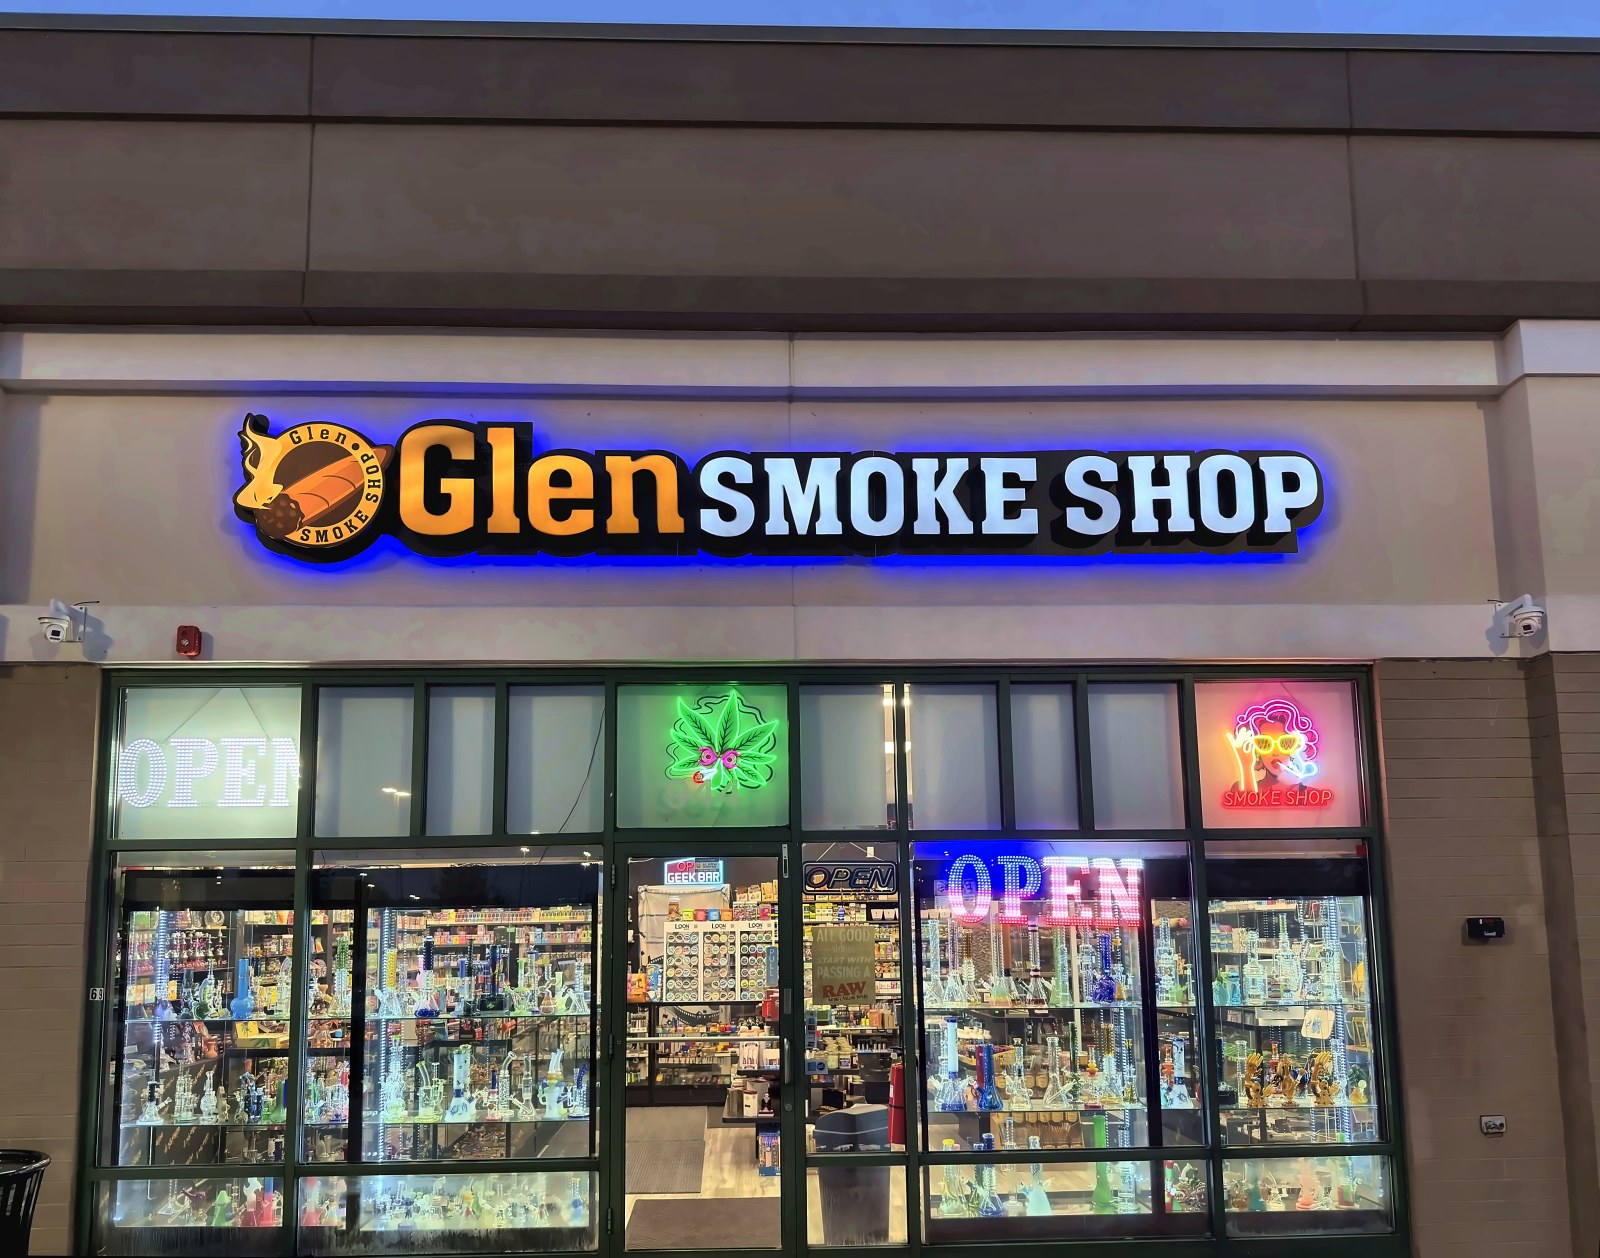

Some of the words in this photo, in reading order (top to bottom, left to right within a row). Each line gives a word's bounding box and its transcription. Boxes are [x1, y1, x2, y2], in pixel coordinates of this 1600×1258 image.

[289, 426, 347, 445] Glen
[399, 424, 685, 536] Glen
[300, 510, 369, 543] SMOKE
[360, 453, 381, 504] SHOP
[699, 456, 1038, 537] SMOKE
[1063, 454, 1318, 536] SHOP
[119, 736, 300, 808] OPEN
[1223, 790, 1281, 806] SMOKE
[1286, 789, 1333, 805] SHOP
[667, 872, 696, 883] GEEK
[697, 871, 720, 882] BAR
[806, 866, 893, 888] OPEN
[947, 854, 1144, 928] OPEN
[816, 928, 834, 942] ALL
[839, 928, 870, 942] GOOD
[816, 956, 844, 964] START
[846, 956, 871, 964] WITH
[817, 966, 861, 979] PASSING
[863, 966, 871, 979] A
[91, 988, 103, 1000] 69
[822, 981, 867, 998] RAW
